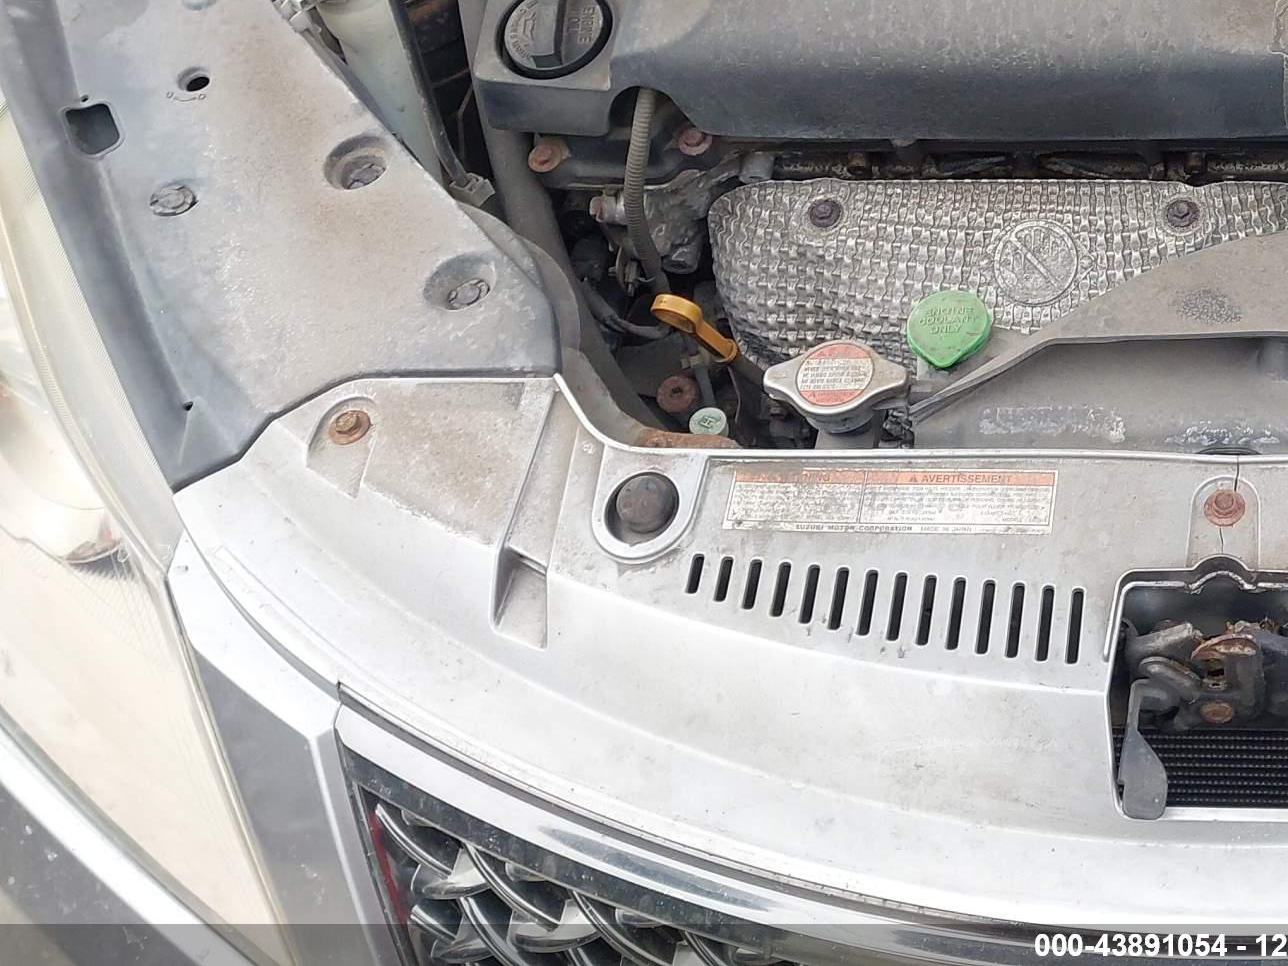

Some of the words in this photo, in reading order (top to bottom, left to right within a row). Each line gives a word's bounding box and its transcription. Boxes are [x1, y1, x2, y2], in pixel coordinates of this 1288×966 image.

[579, 6, 597, 43] ENGINE
[926, 306, 974, 317] ENGINE
[919, 315, 978, 325] COOLANT
[930, 324, 963, 334] ONLY
[922, 474, 1012, 483] AVERTISSEMENT
